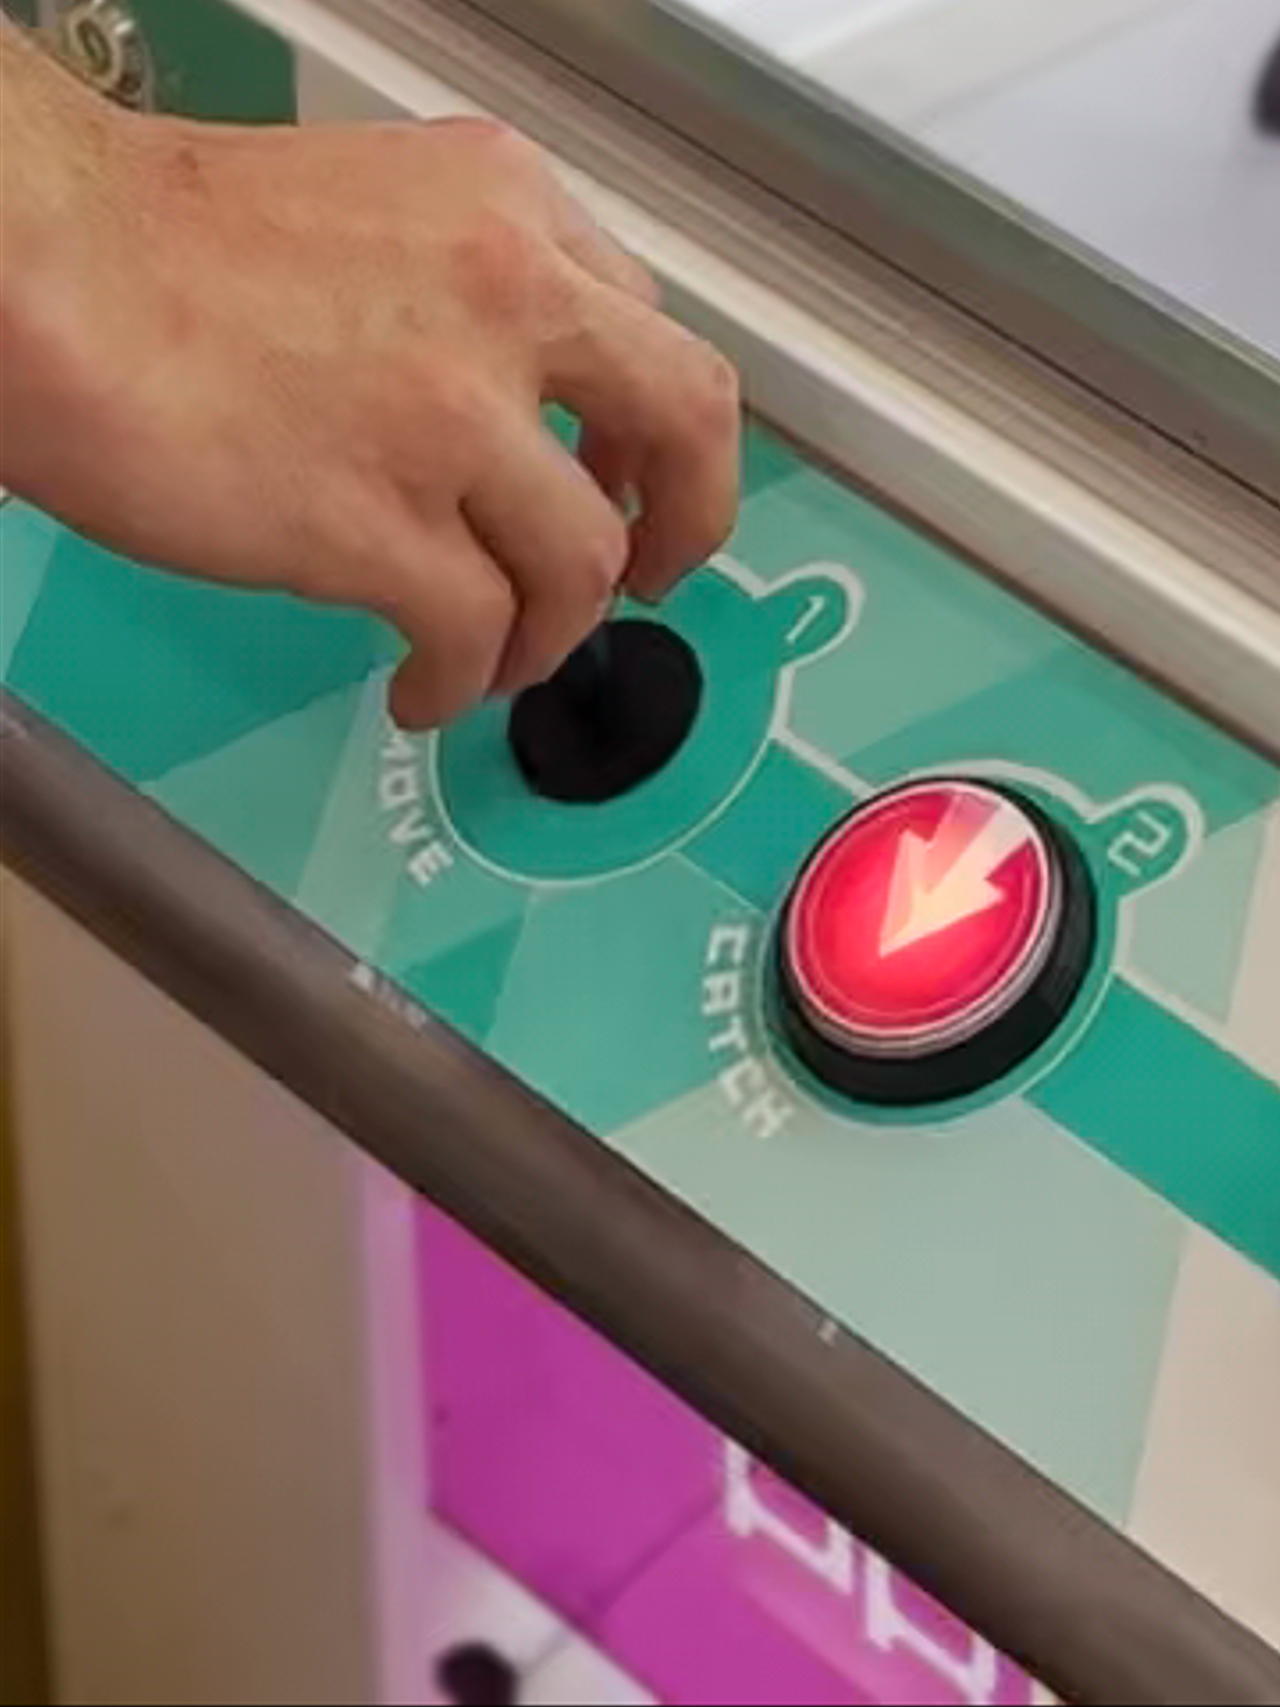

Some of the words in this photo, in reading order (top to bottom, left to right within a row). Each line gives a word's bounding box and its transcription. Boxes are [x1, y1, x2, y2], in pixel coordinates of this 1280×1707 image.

[785, 593, 824, 644] 1
[1107, 819, 1174, 878] 2
[700, 924, 796, 1138] CATCH
